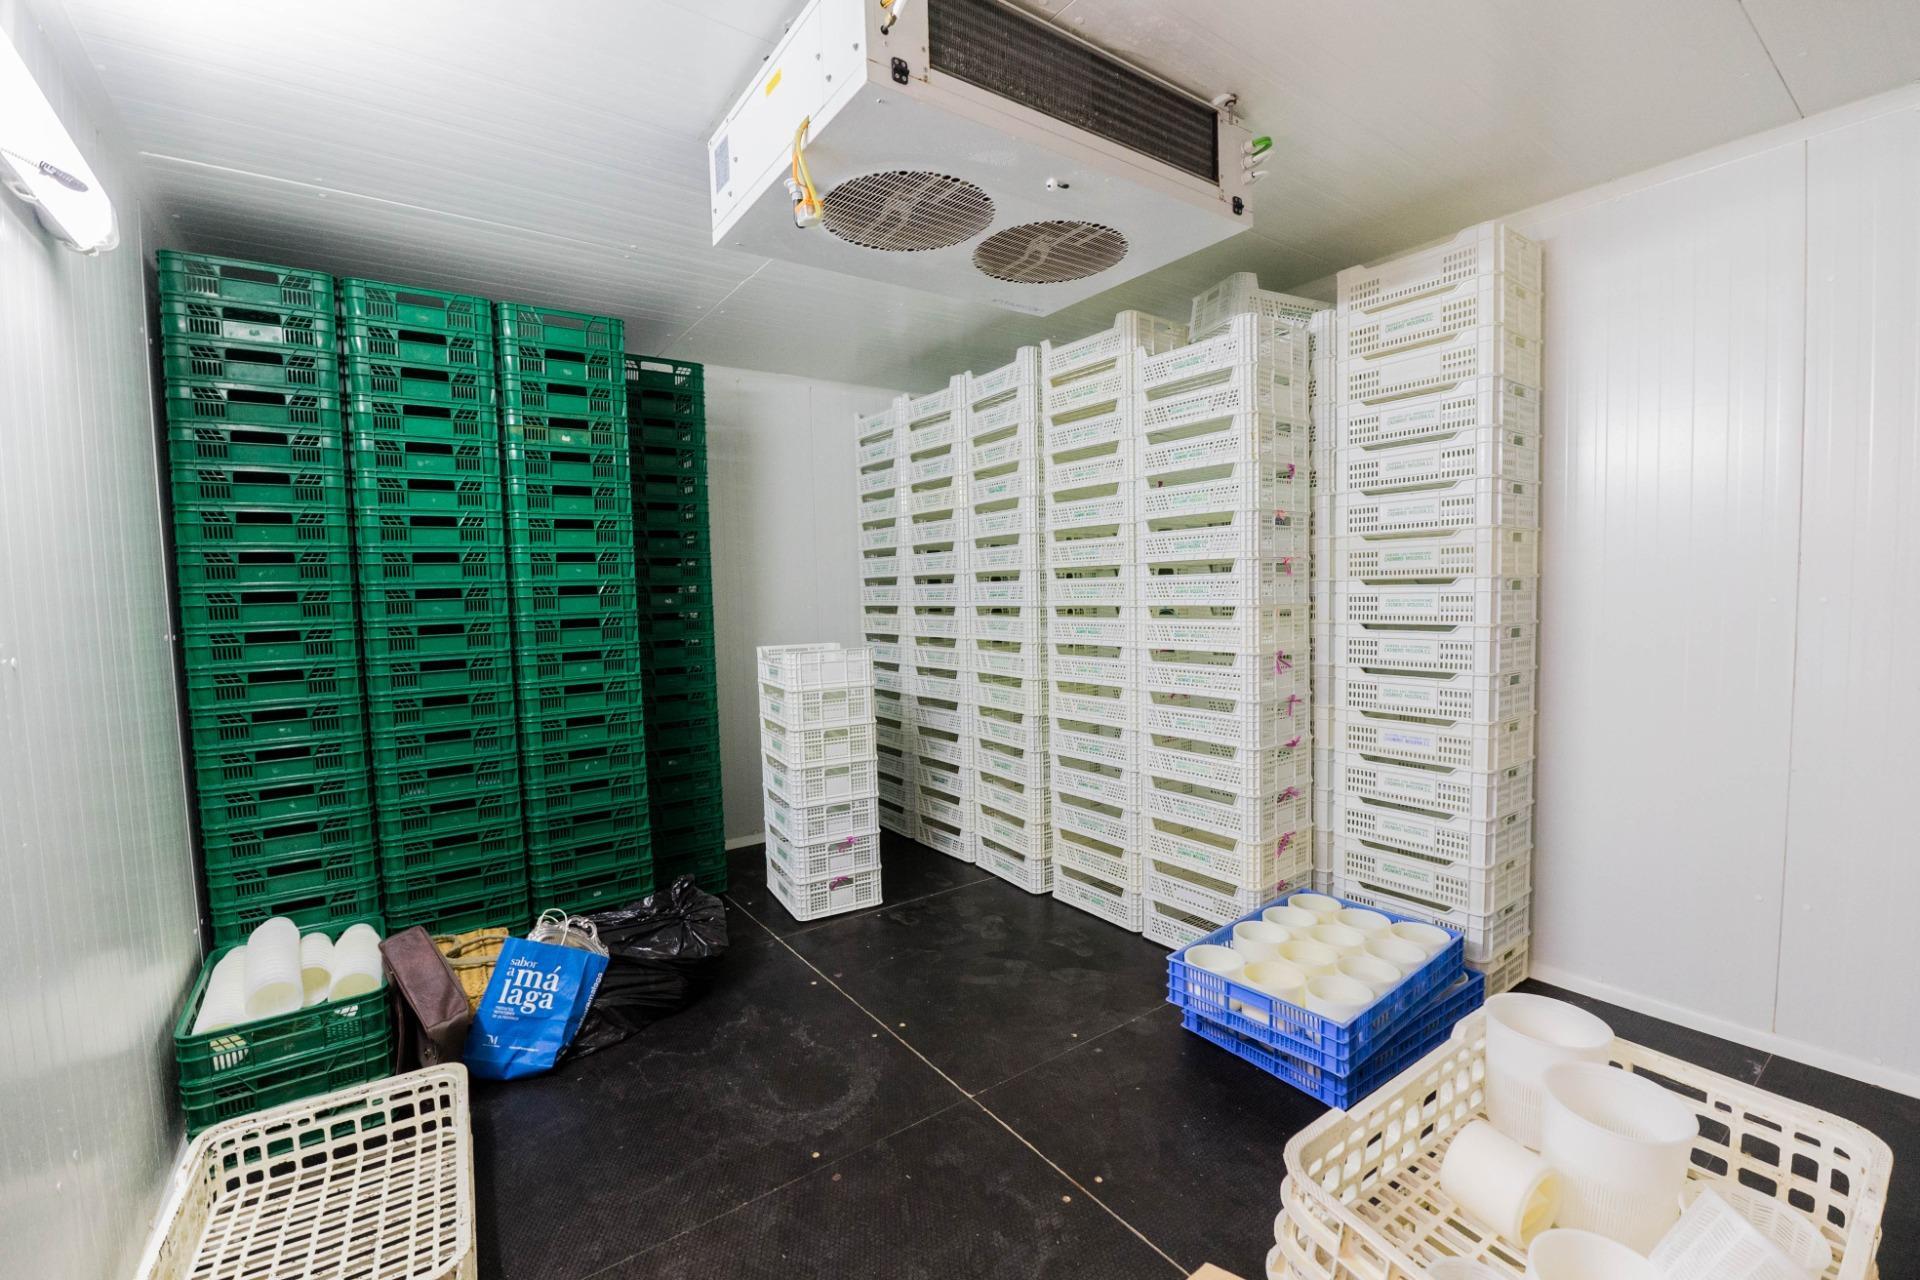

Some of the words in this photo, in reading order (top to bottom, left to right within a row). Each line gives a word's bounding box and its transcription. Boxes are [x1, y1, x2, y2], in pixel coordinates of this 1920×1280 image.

[510, 956, 538, 968] sabor
[506, 966, 515, 977] a
[513, 965, 562, 992] má
[497, 978, 554, 1014] laga
